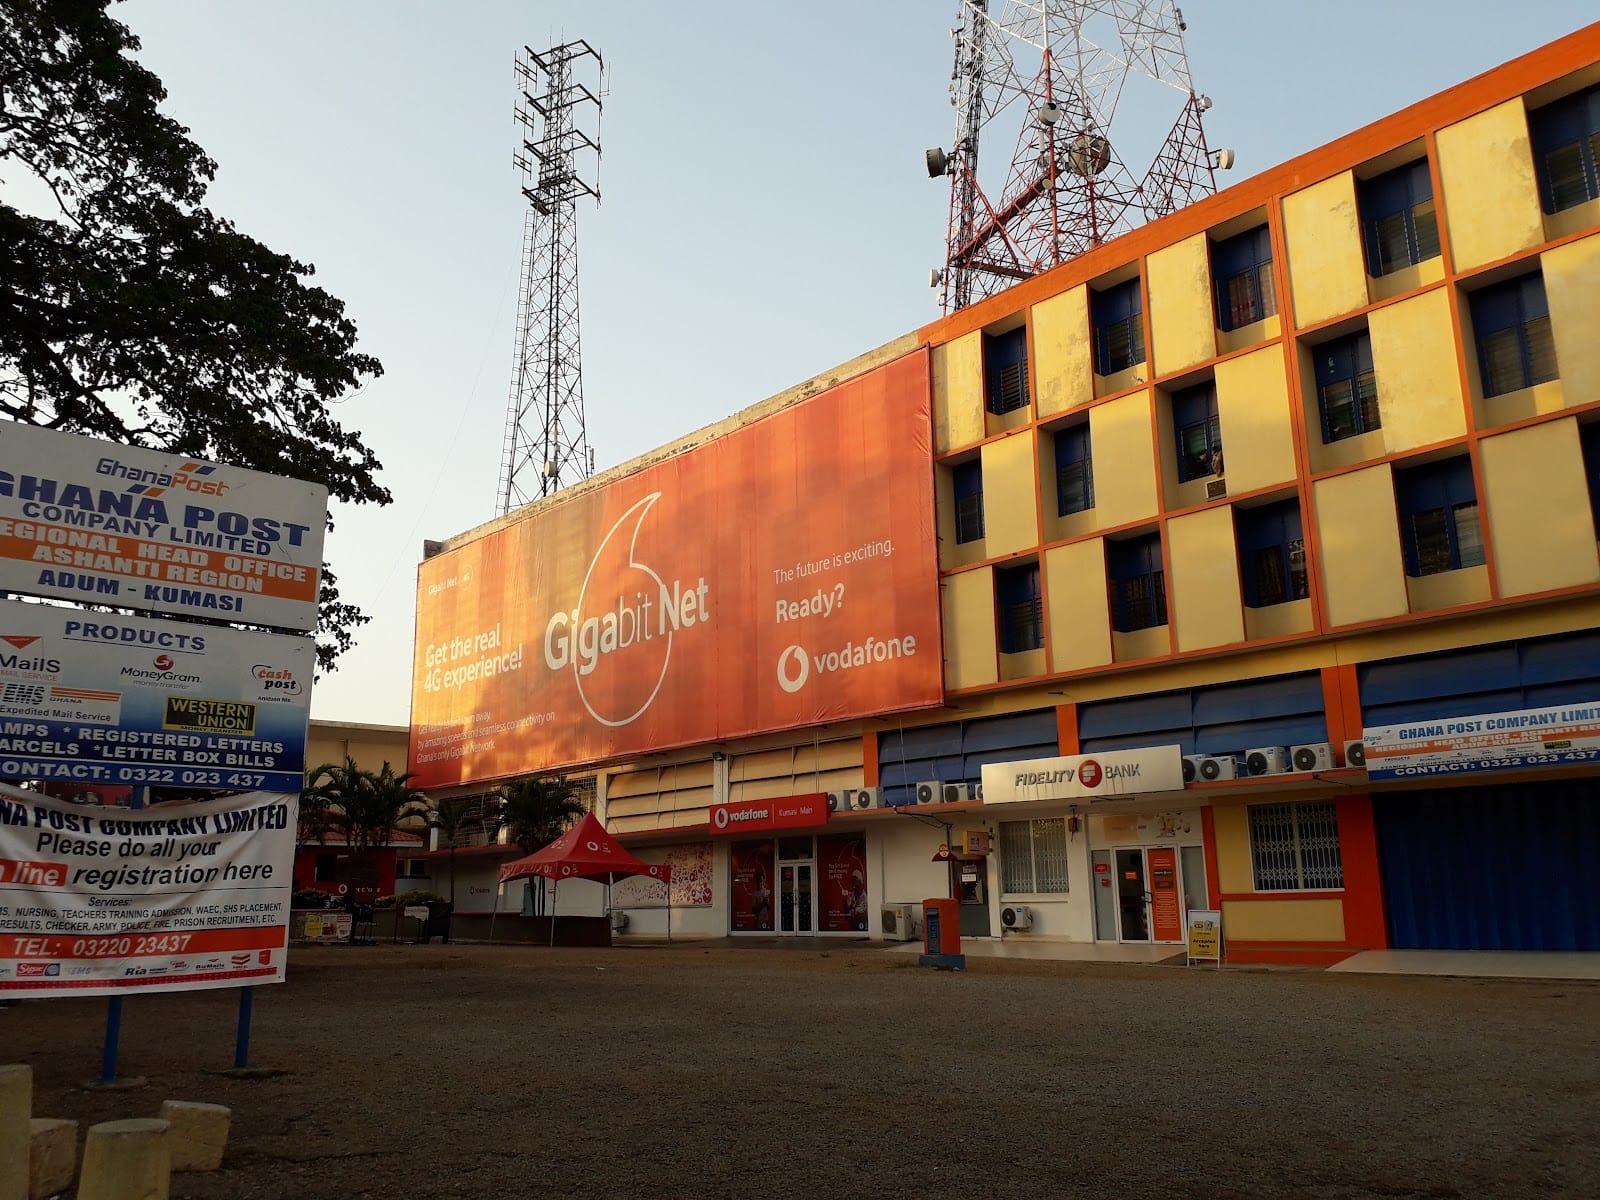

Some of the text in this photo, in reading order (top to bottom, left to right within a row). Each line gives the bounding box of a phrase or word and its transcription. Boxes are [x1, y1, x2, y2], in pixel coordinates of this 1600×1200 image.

[96, 457, 230, 497] GhanaPost
[22, 502, 271, 556] COMPANY LIMITED
[184, 504, 311, 547] POST
[32, 545, 263, 593] ASHANTI REGION
[138, 543, 208, 567] HEAD
[223, 556, 307, 583] OFFICE
[773, 539, 895, 585] The future is exciting.
[38, 569, 120, 596] ADUM
[144, 584, 243, 613] KUMASI
[775, 582, 845, 624] Ready?
[64, 620, 205, 650] PRODUCTS
[544, 577, 709, 676] Gigabit Net
[425, 622, 501, 668] Get the real
[814, 635, 916, 674] vodafone
[120, 666, 201, 683] MoneyGram
[258, 669, 293, 680] cash
[424, 642, 523, 692] 4G experience!
[264, 679, 297, 690] post
[0, 704, 112, 722] Expedited Mail Service
[171, 698, 250, 718] WESTERN
[0, 722, 284, 754] MPS REGISTERED LETTERS
[198, 716, 249, 731] UNION
[1399, 725, 1445, 740] GHANA
[1447, 720, 1483, 734] POST
[1486, 712, 1558, 730] COMPANY
[1375, 741, 1431, 753] REGIONAL
[1434, 737, 1464, 746] HEAD
[1469, 733, 1509, 745] OFFICE
[1520, 726, 1576, 737] ASHANTI
[183, 750, 220, 764] BOX
[226, 753, 275, 767] BILLS
[1395, 750, 1598, 776] CONTACT: 0322 023 437
[0, 761, 266, 787] ONTACT: 0322 023 437
[1015, 763, 1141, 787] FIDELITY BANK
[34, 806, 95, 834] POST
[99, 815, 208, 836] COMPANY
[213, 803, 287, 834] LIMITED
[730, 808, 769, 821] vodafone
[36, 832, 221, 862] Please do all your
[12, 862, 60, 886] line
[72, 863, 219, 890] registration
[222, 861, 273, 881] here
[62, 909, 107, 919] TEACHERS
[108, 909, 149, 919] TRAINING
[223, 904, 238, 914] SHS
[174, 918, 206, 928] PRISON
[13, 935, 192, 956] TEL: 03220 23437
